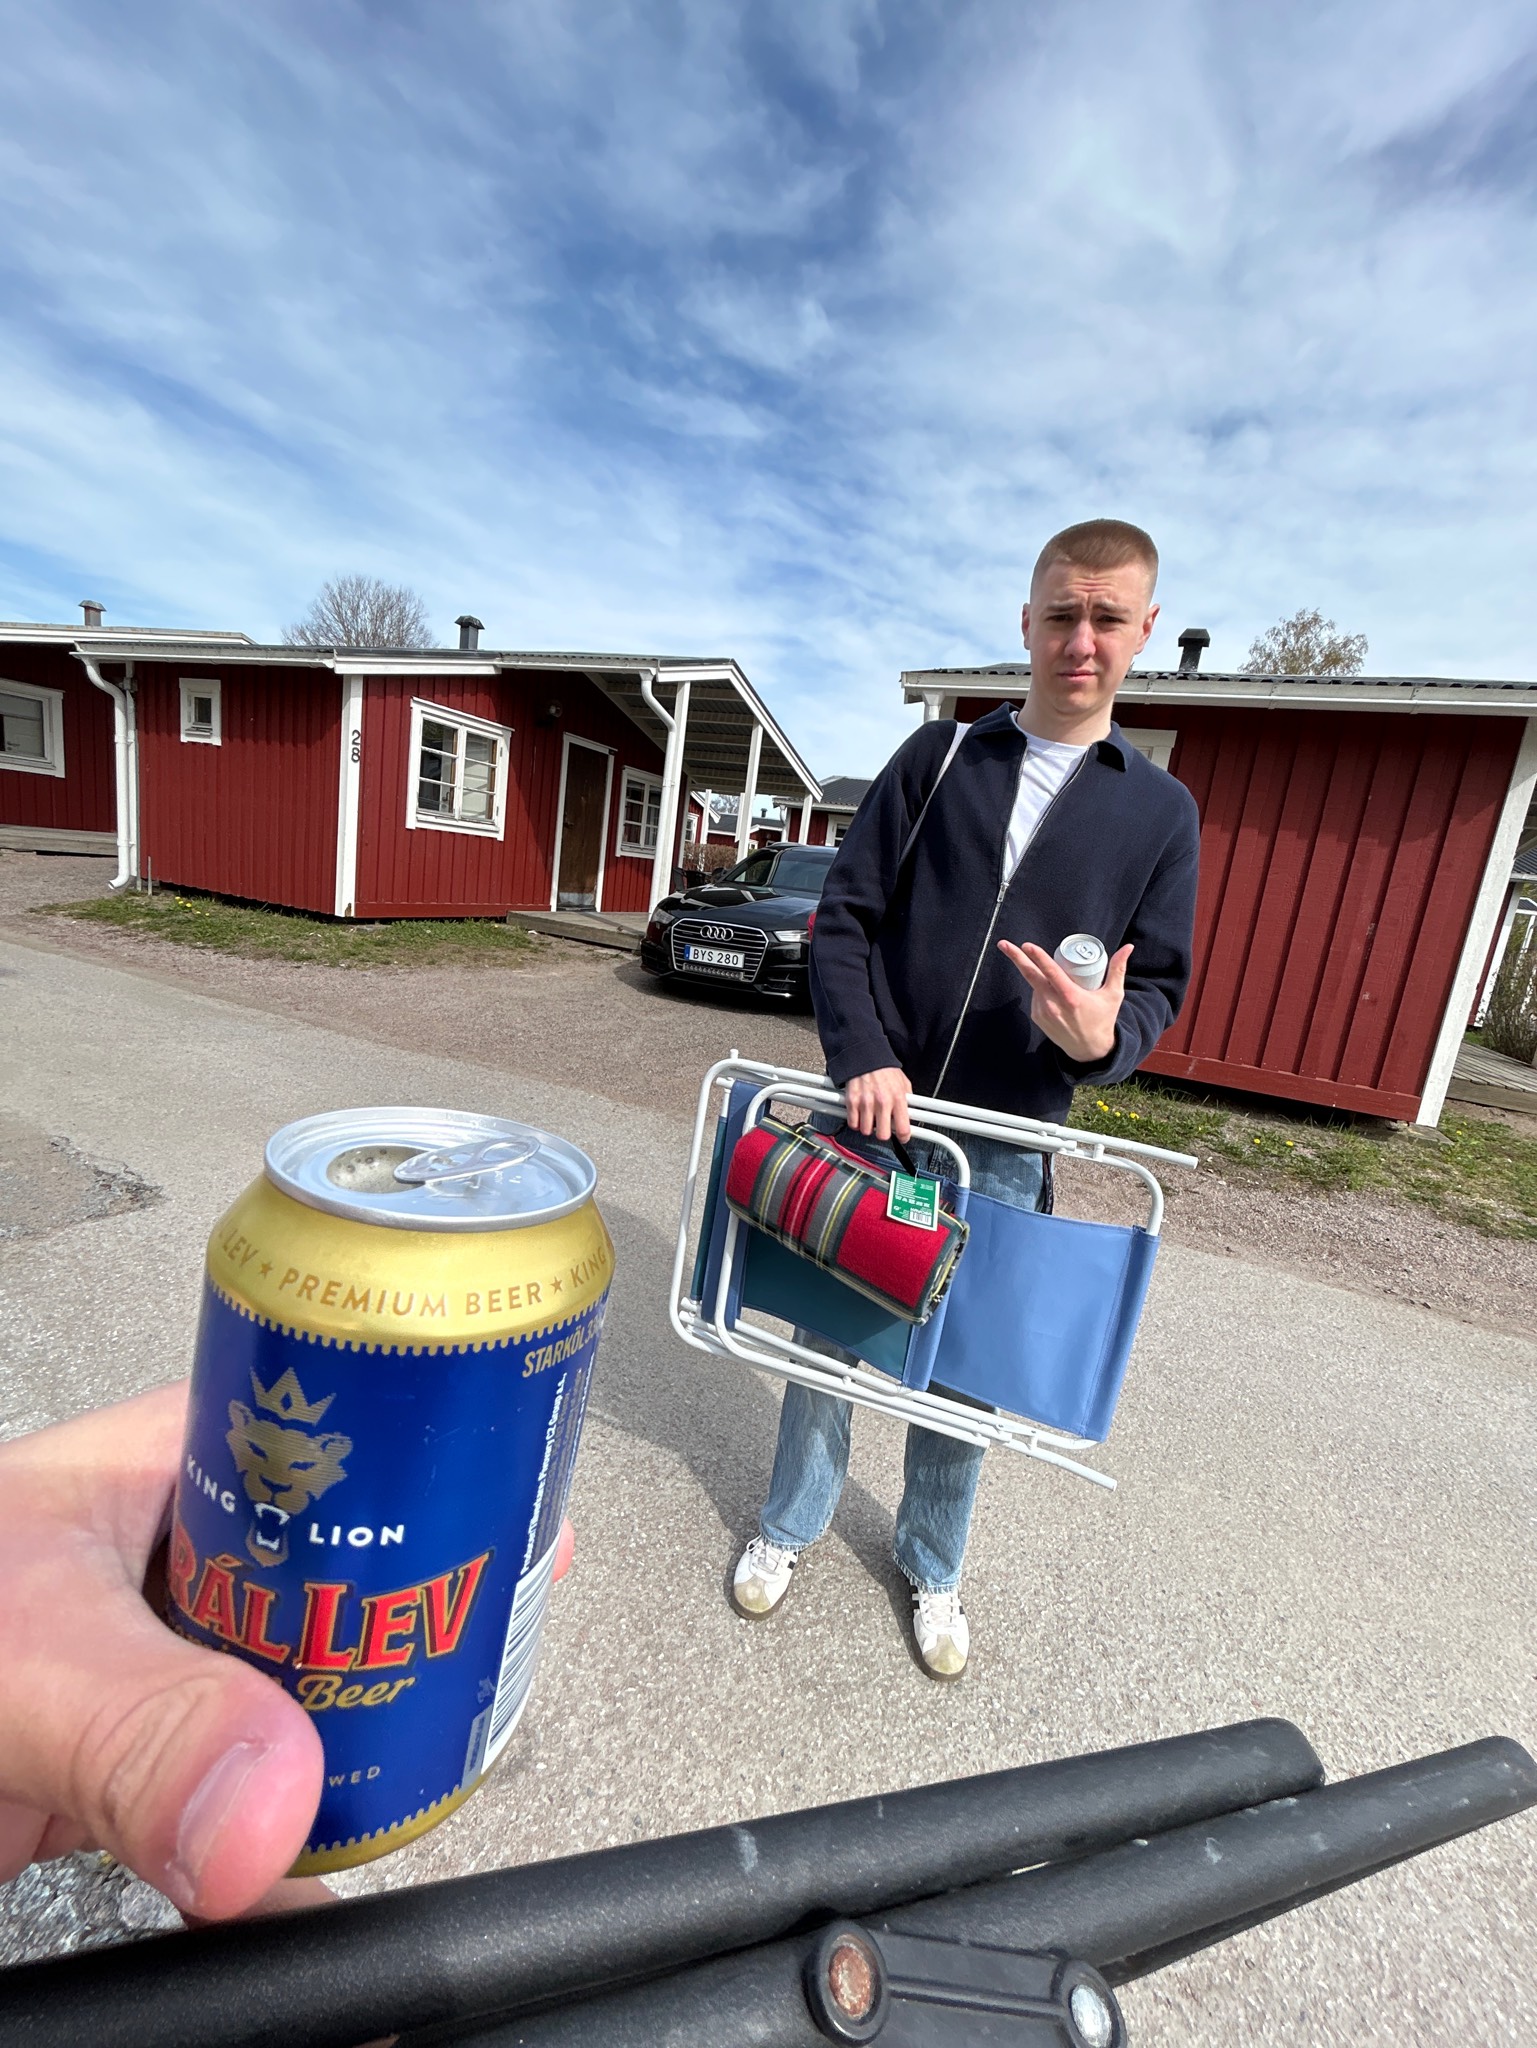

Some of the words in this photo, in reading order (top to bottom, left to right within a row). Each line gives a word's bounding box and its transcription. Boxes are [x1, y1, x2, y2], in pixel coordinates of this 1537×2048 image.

[351, 729, 361, 763] 28
[693, 949, 713, 961] BYS
[717, 952, 739, 965] 280
[278, 1267, 446, 1318] PREMIUM
[465, 1281, 542, 1315] BEER
[570, 1246, 606, 1288] KING
[522, 1325, 585, 1378] STARKÖL
[186, 1454, 236, 1513] KING
[309, 1522, 405, 1547] LION
[296, 1551, 490, 1670] LEV
[297, 1673, 416, 1711] Beer
